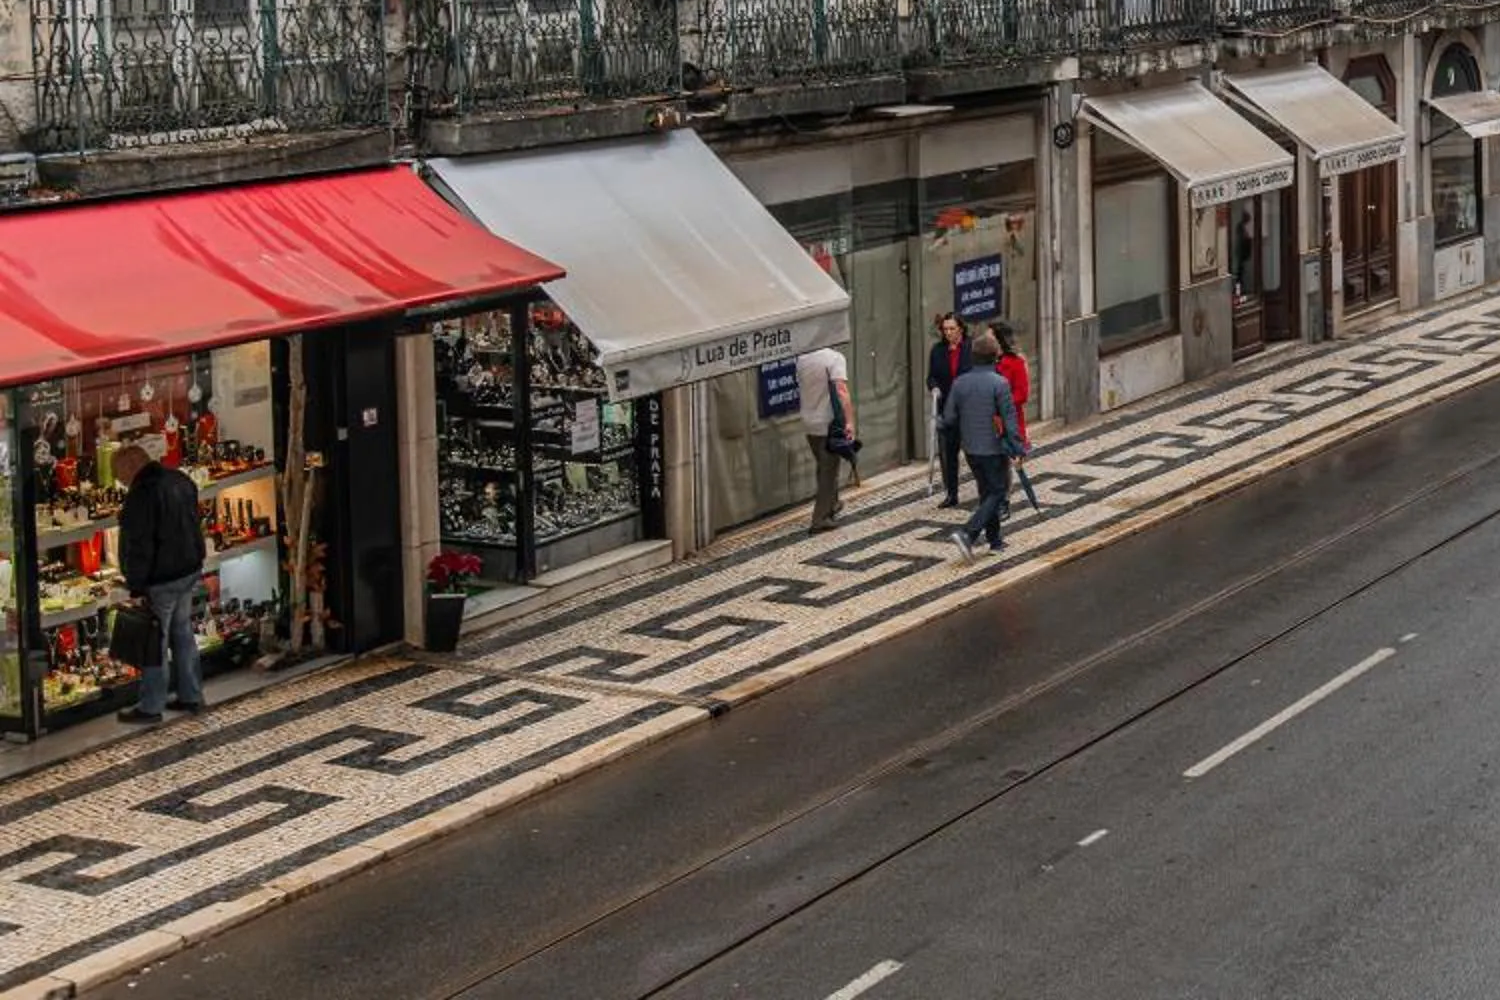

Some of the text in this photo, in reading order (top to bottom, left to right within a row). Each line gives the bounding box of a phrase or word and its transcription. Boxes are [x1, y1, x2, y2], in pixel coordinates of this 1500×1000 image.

[696, 345, 725, 366] Lua
[730, 337, 748, 357] de
[753, 328, 791, 350] Prata
[649, 399, 659, 425] DE
